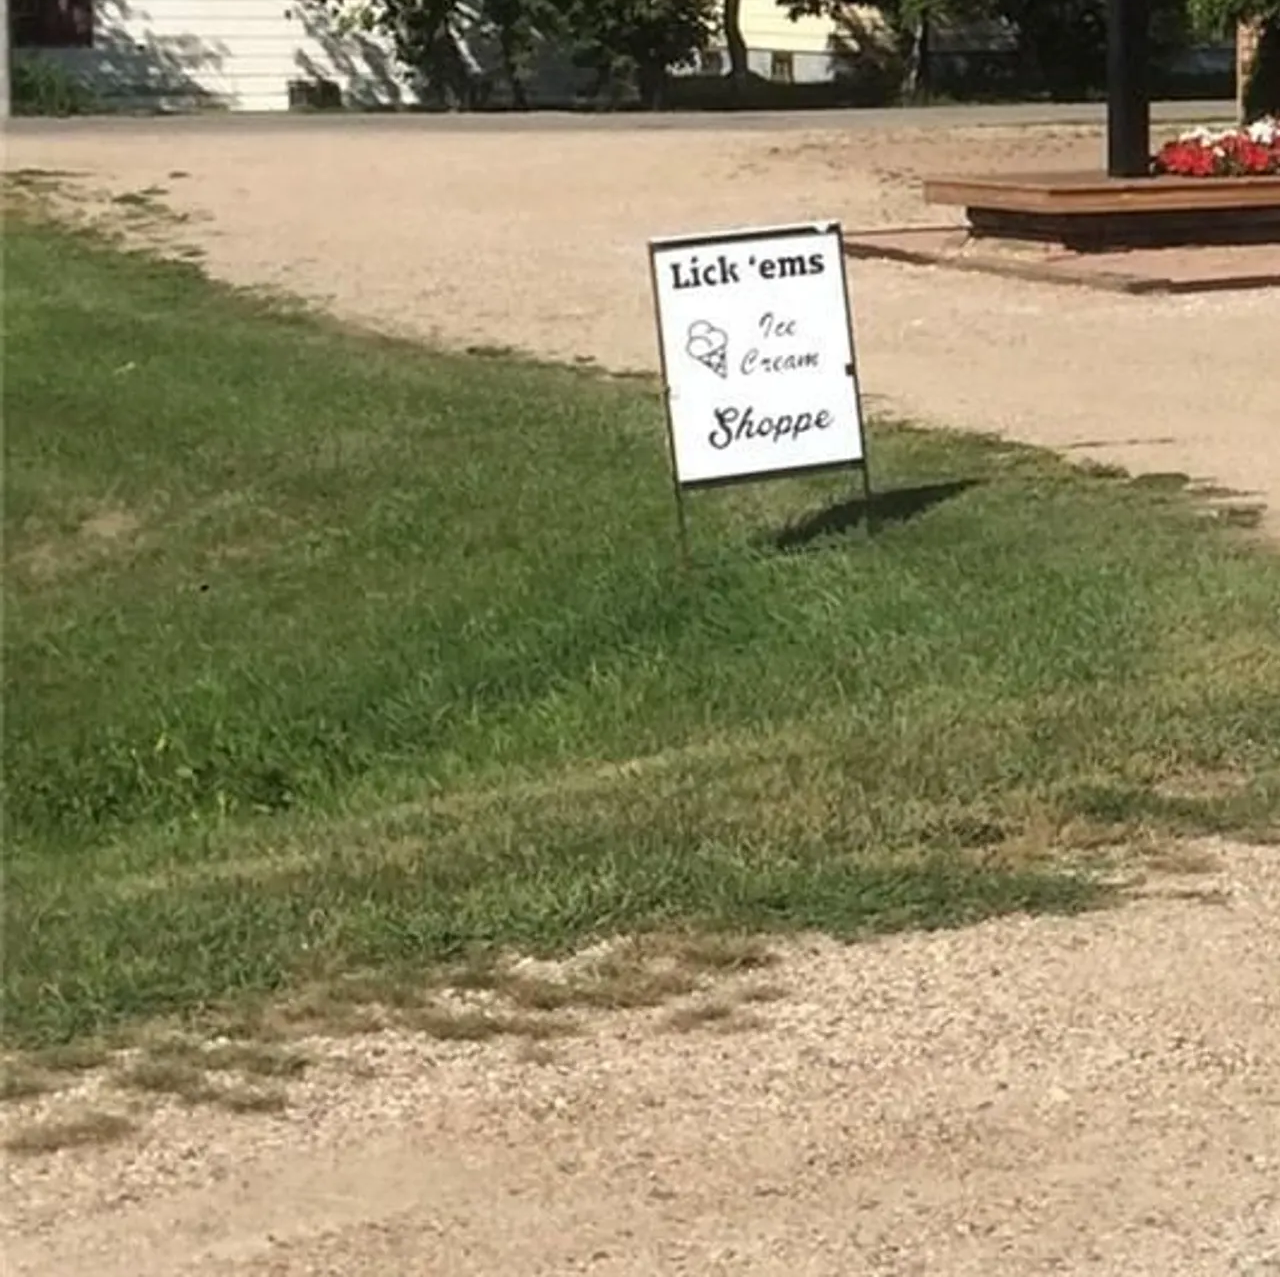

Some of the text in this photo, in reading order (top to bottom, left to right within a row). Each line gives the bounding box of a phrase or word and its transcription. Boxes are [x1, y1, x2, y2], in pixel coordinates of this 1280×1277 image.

[670, 255, 740, 290] Lick
[759, 311, 797, 339] Ice
[740, 347, 819, 376] Cream
[707, 405, 833, 450] Shoppe
